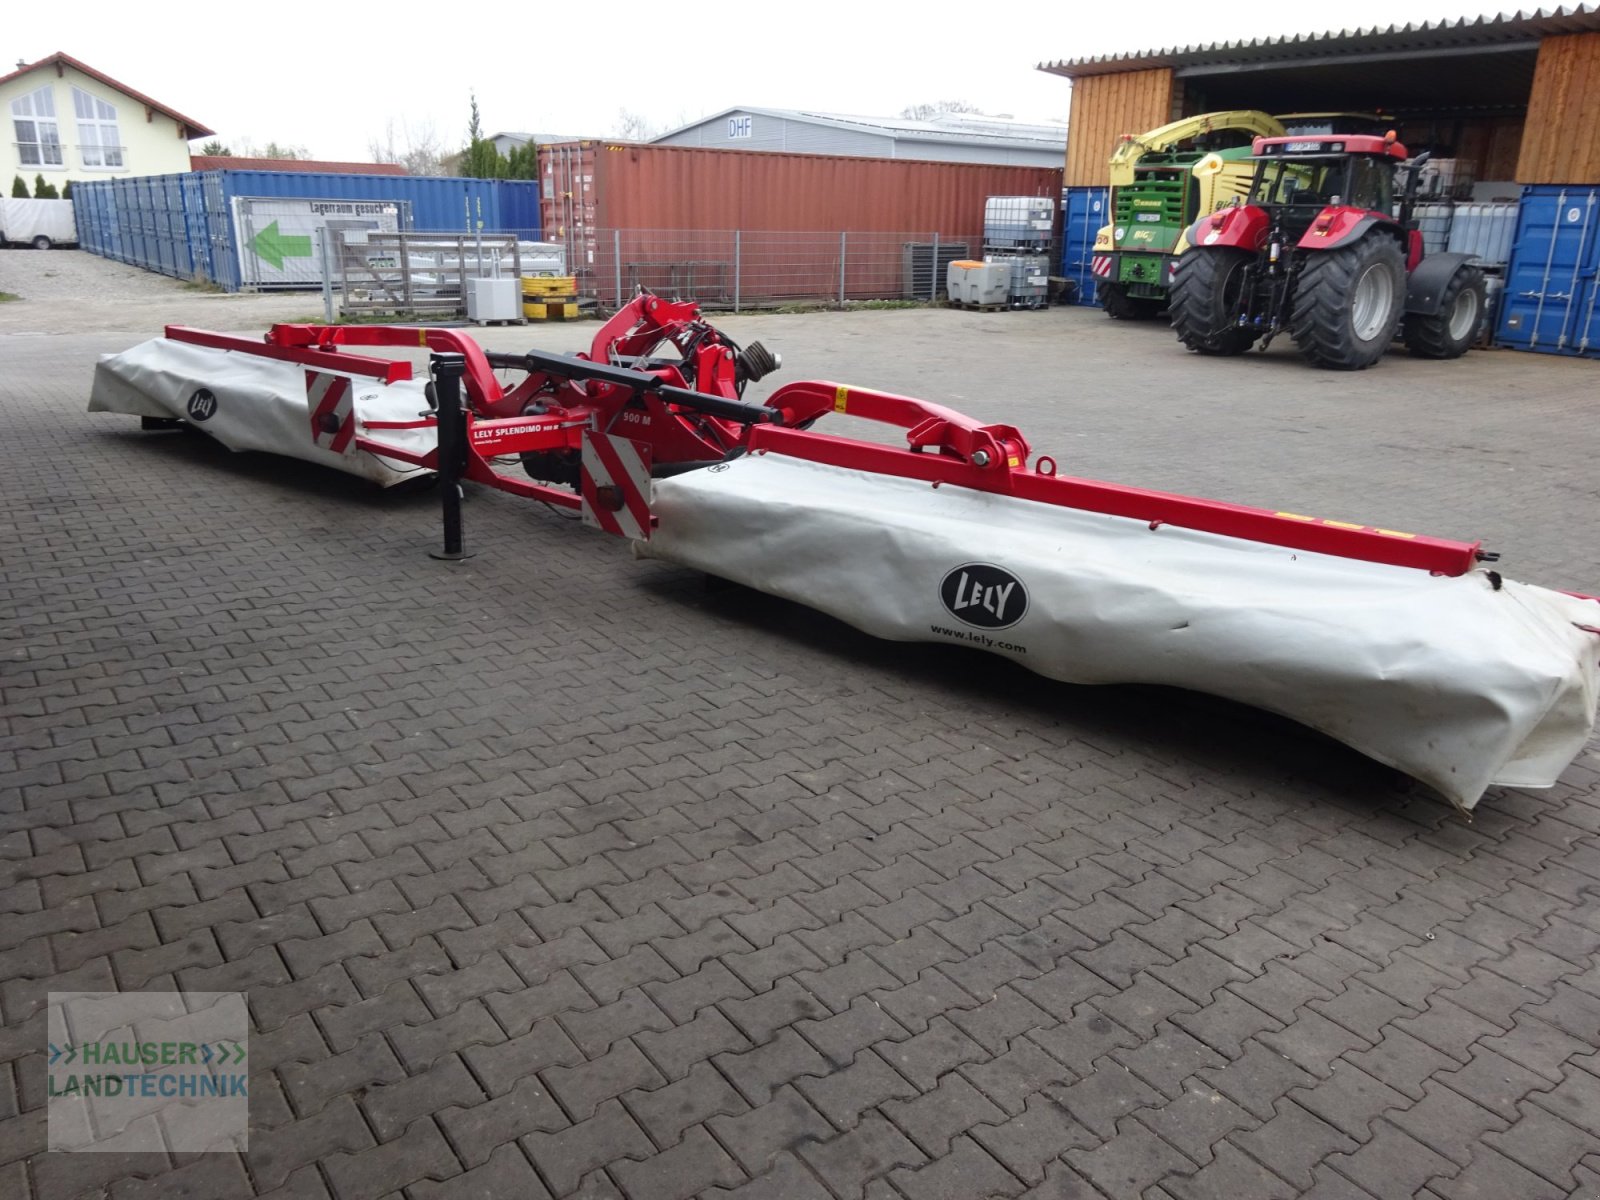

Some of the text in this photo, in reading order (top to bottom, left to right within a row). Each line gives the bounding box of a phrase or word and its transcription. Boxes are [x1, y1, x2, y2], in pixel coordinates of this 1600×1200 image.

[729, 118, 752, 137] DHF
[309, 201, 353, 216] Lagerraum
[191, 394, 214, 417] LELY
[623, 411, 652, 426] 900 M
[474, 429, 493, 439] LELY
[953, 571, 1016, 620] LELY
[931, 625, 1027, 653] www.lely.com
